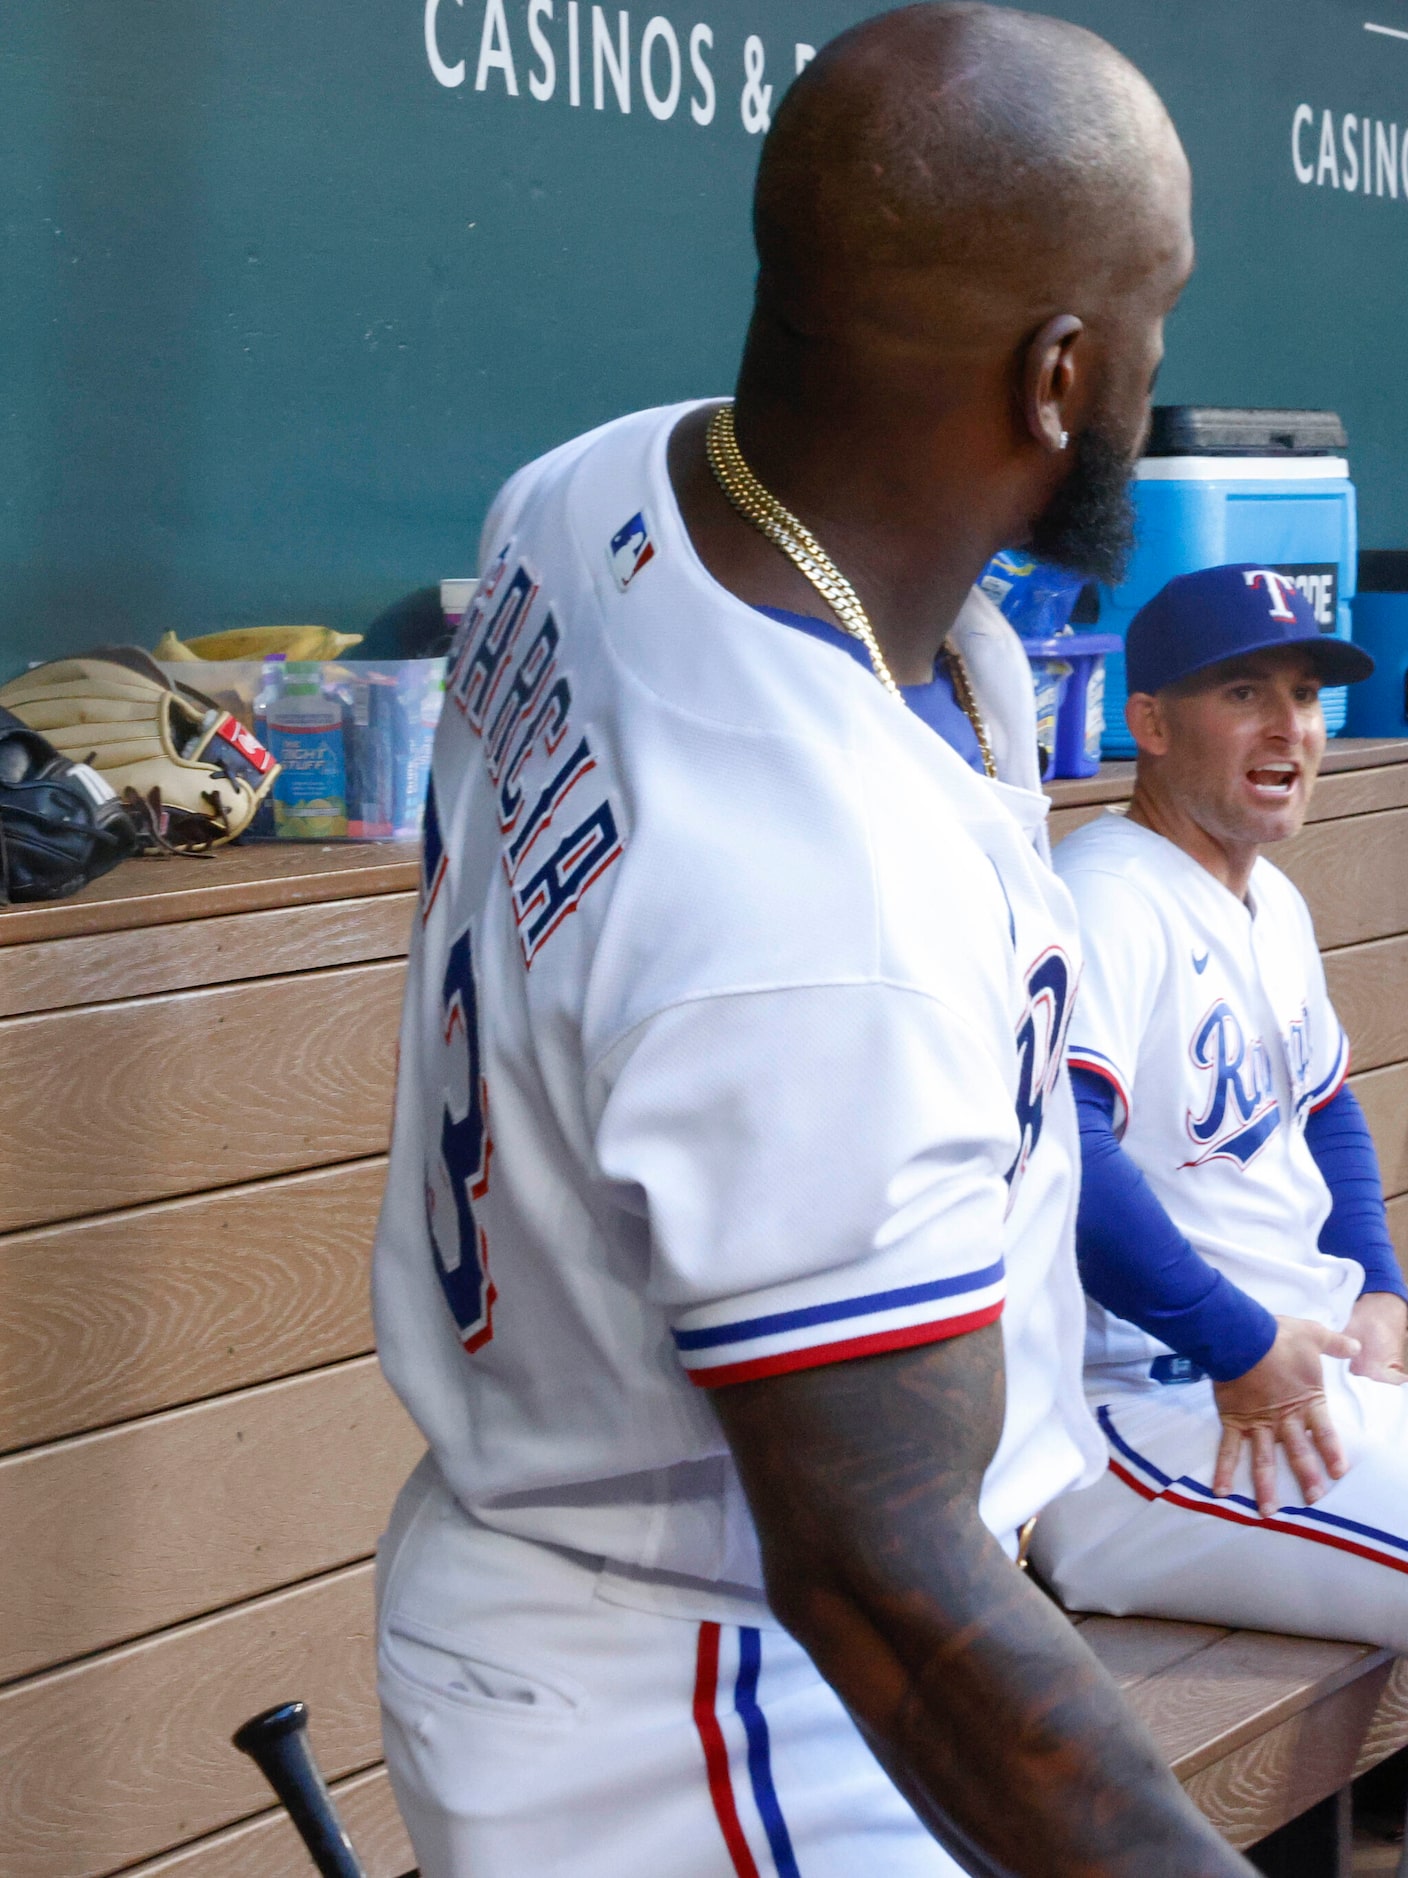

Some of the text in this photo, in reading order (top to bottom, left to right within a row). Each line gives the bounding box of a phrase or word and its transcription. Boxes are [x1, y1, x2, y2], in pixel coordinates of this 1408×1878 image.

[423, 0, 773, 134] CASINOS &
[1243, 569, 1297, 624] T
